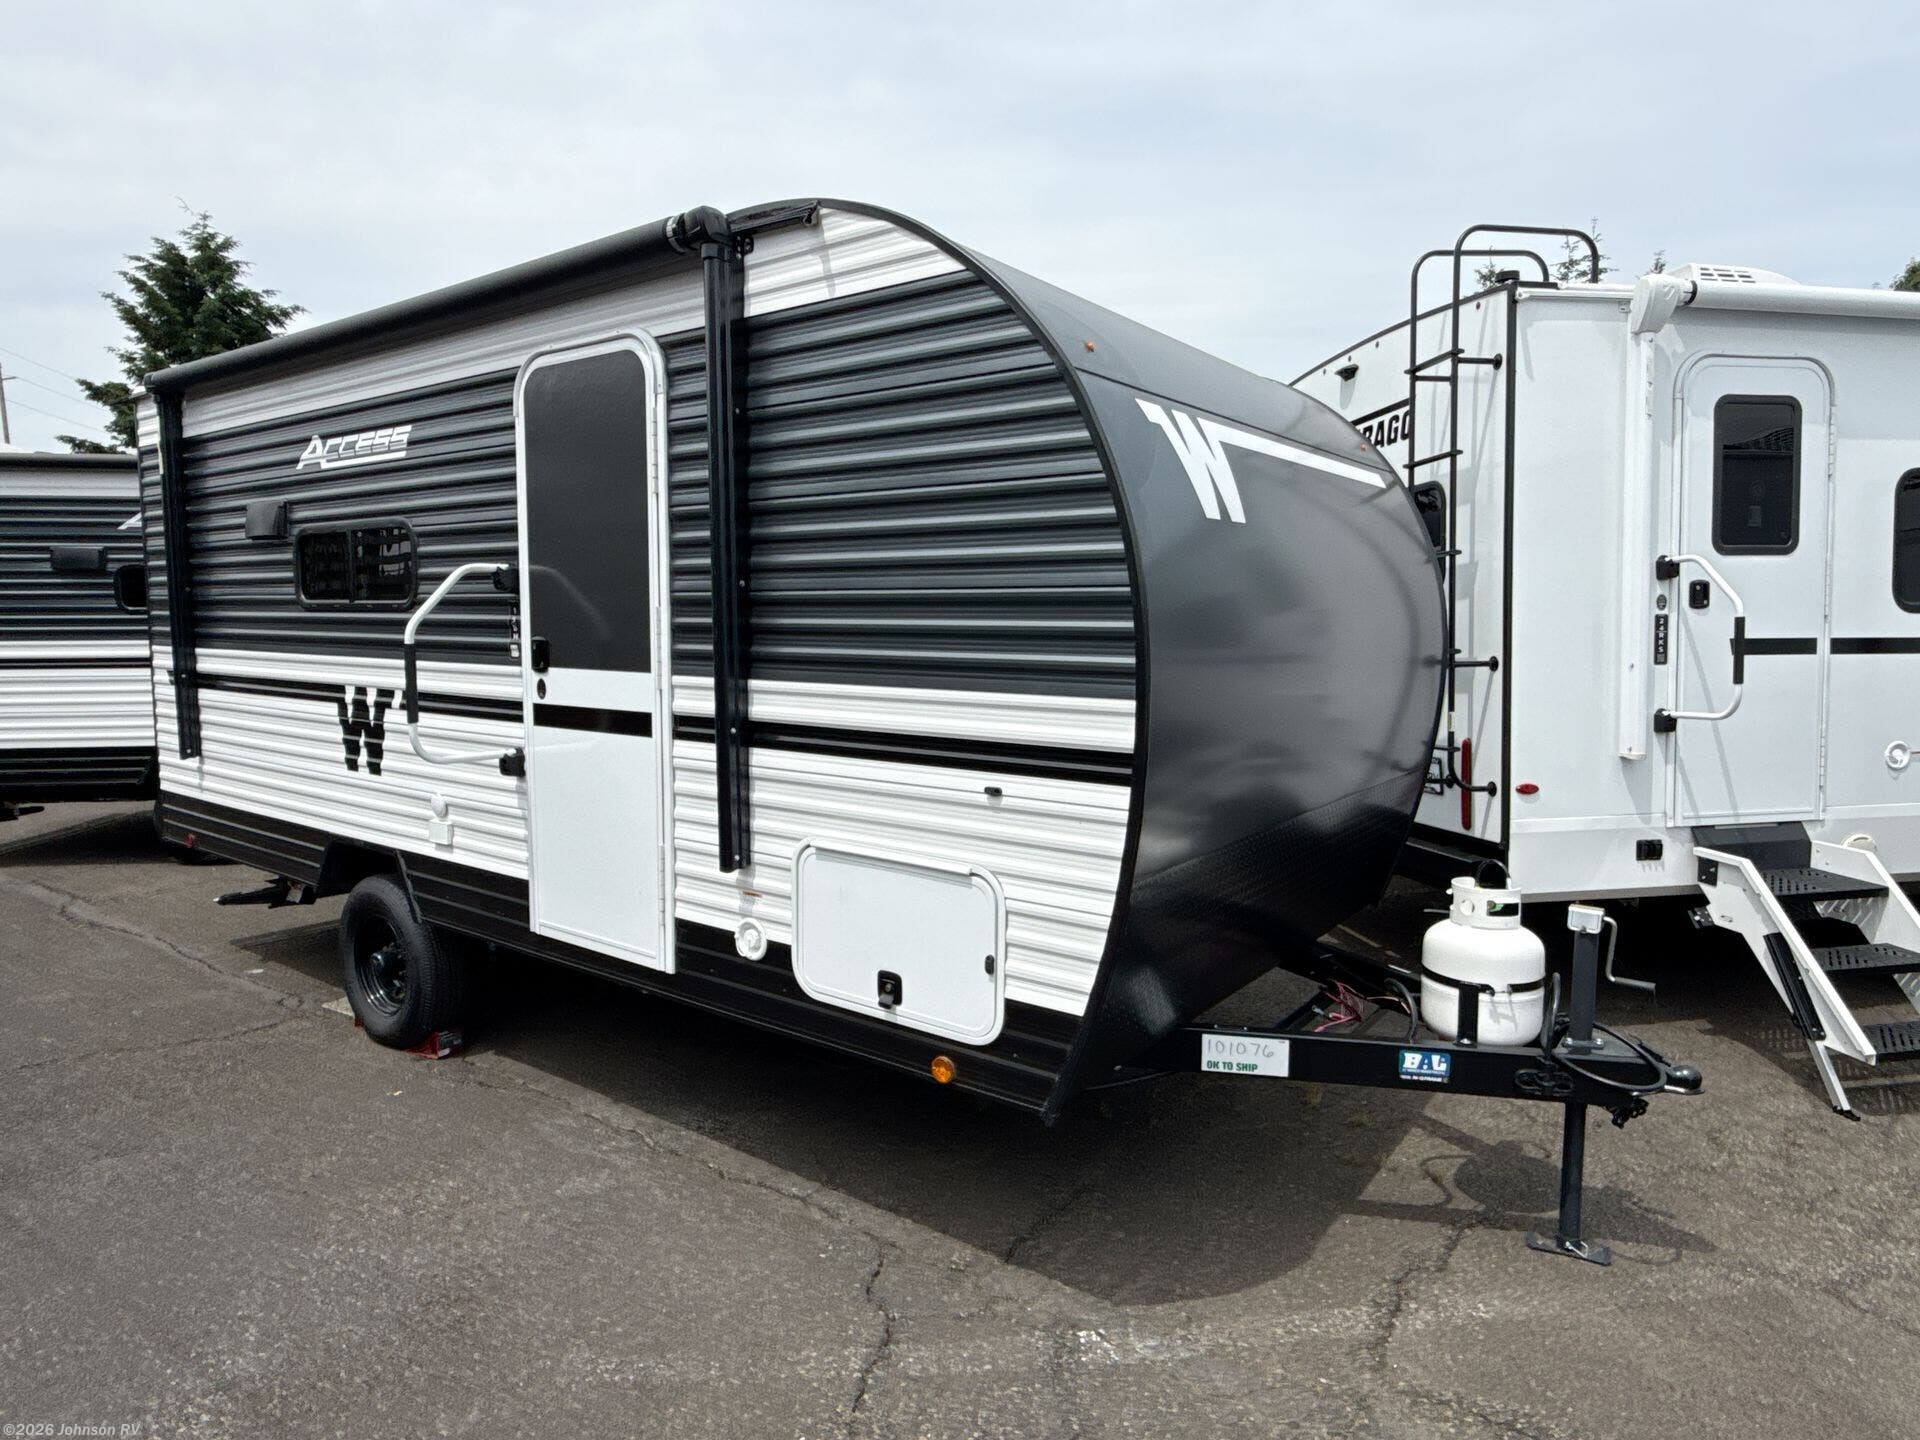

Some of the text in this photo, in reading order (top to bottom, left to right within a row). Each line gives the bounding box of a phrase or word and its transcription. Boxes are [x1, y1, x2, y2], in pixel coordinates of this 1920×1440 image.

[296, 425, 413, 470] ACCESS
[1207, 1039, 1274, 1058] 101076
[1206, 1060, 1258, 1072] OK TO SHIP
[1403, 1052, 1447, 1071] BAL
